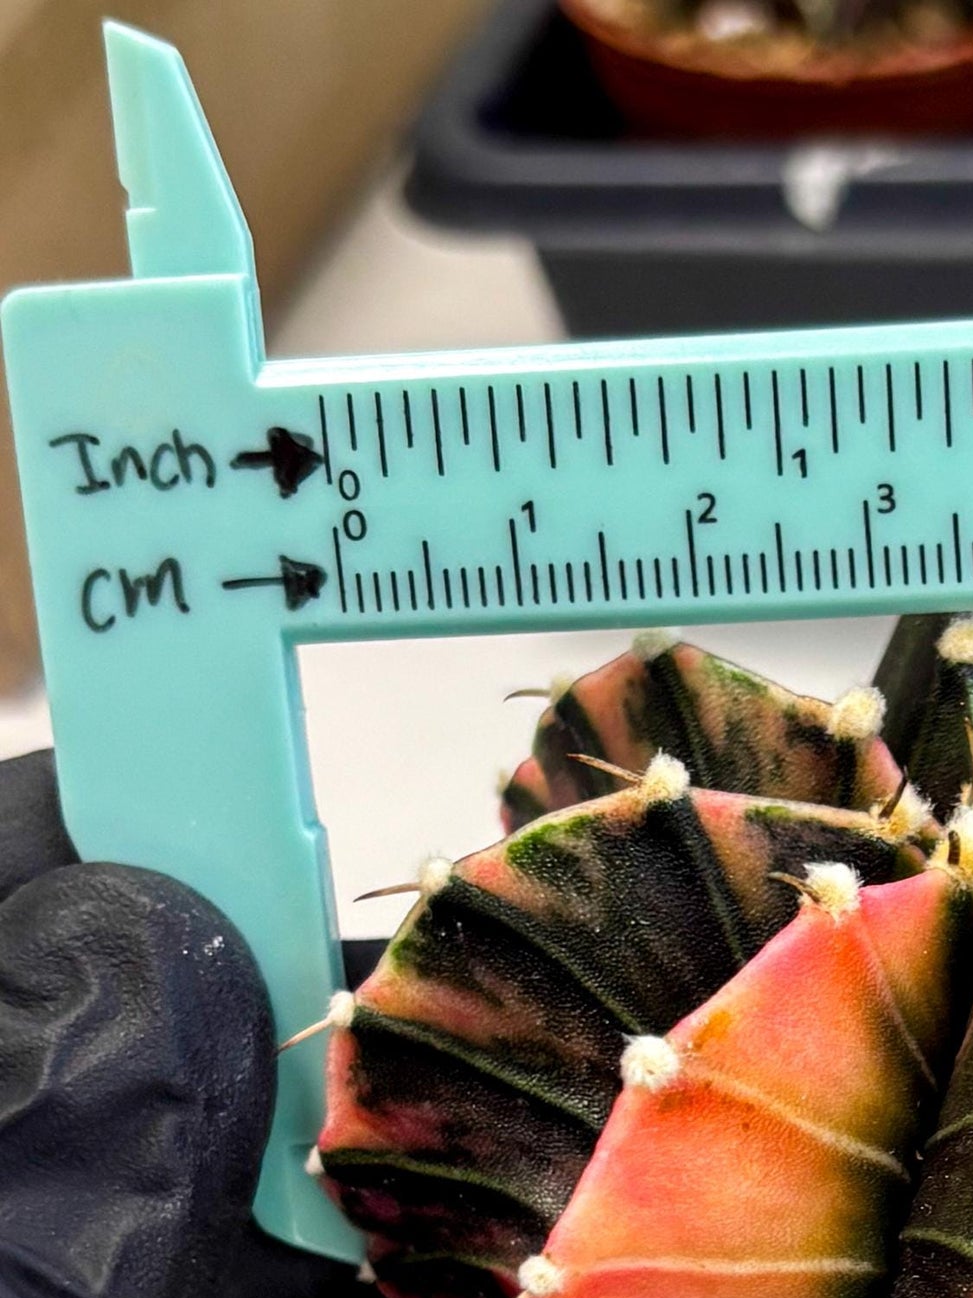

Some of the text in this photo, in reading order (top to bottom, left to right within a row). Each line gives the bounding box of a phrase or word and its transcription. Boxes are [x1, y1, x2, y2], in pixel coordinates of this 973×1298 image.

[49, 429, 216, 495] Inch
[339, 470, 360, 501] 0
[792, 449, 807, 478] 1
[343, 510, 367, 541] 0
[522, 501, 536, 532] 1
[698, 493, 717, 523] 2
[878, 484, 896, 513] 3
